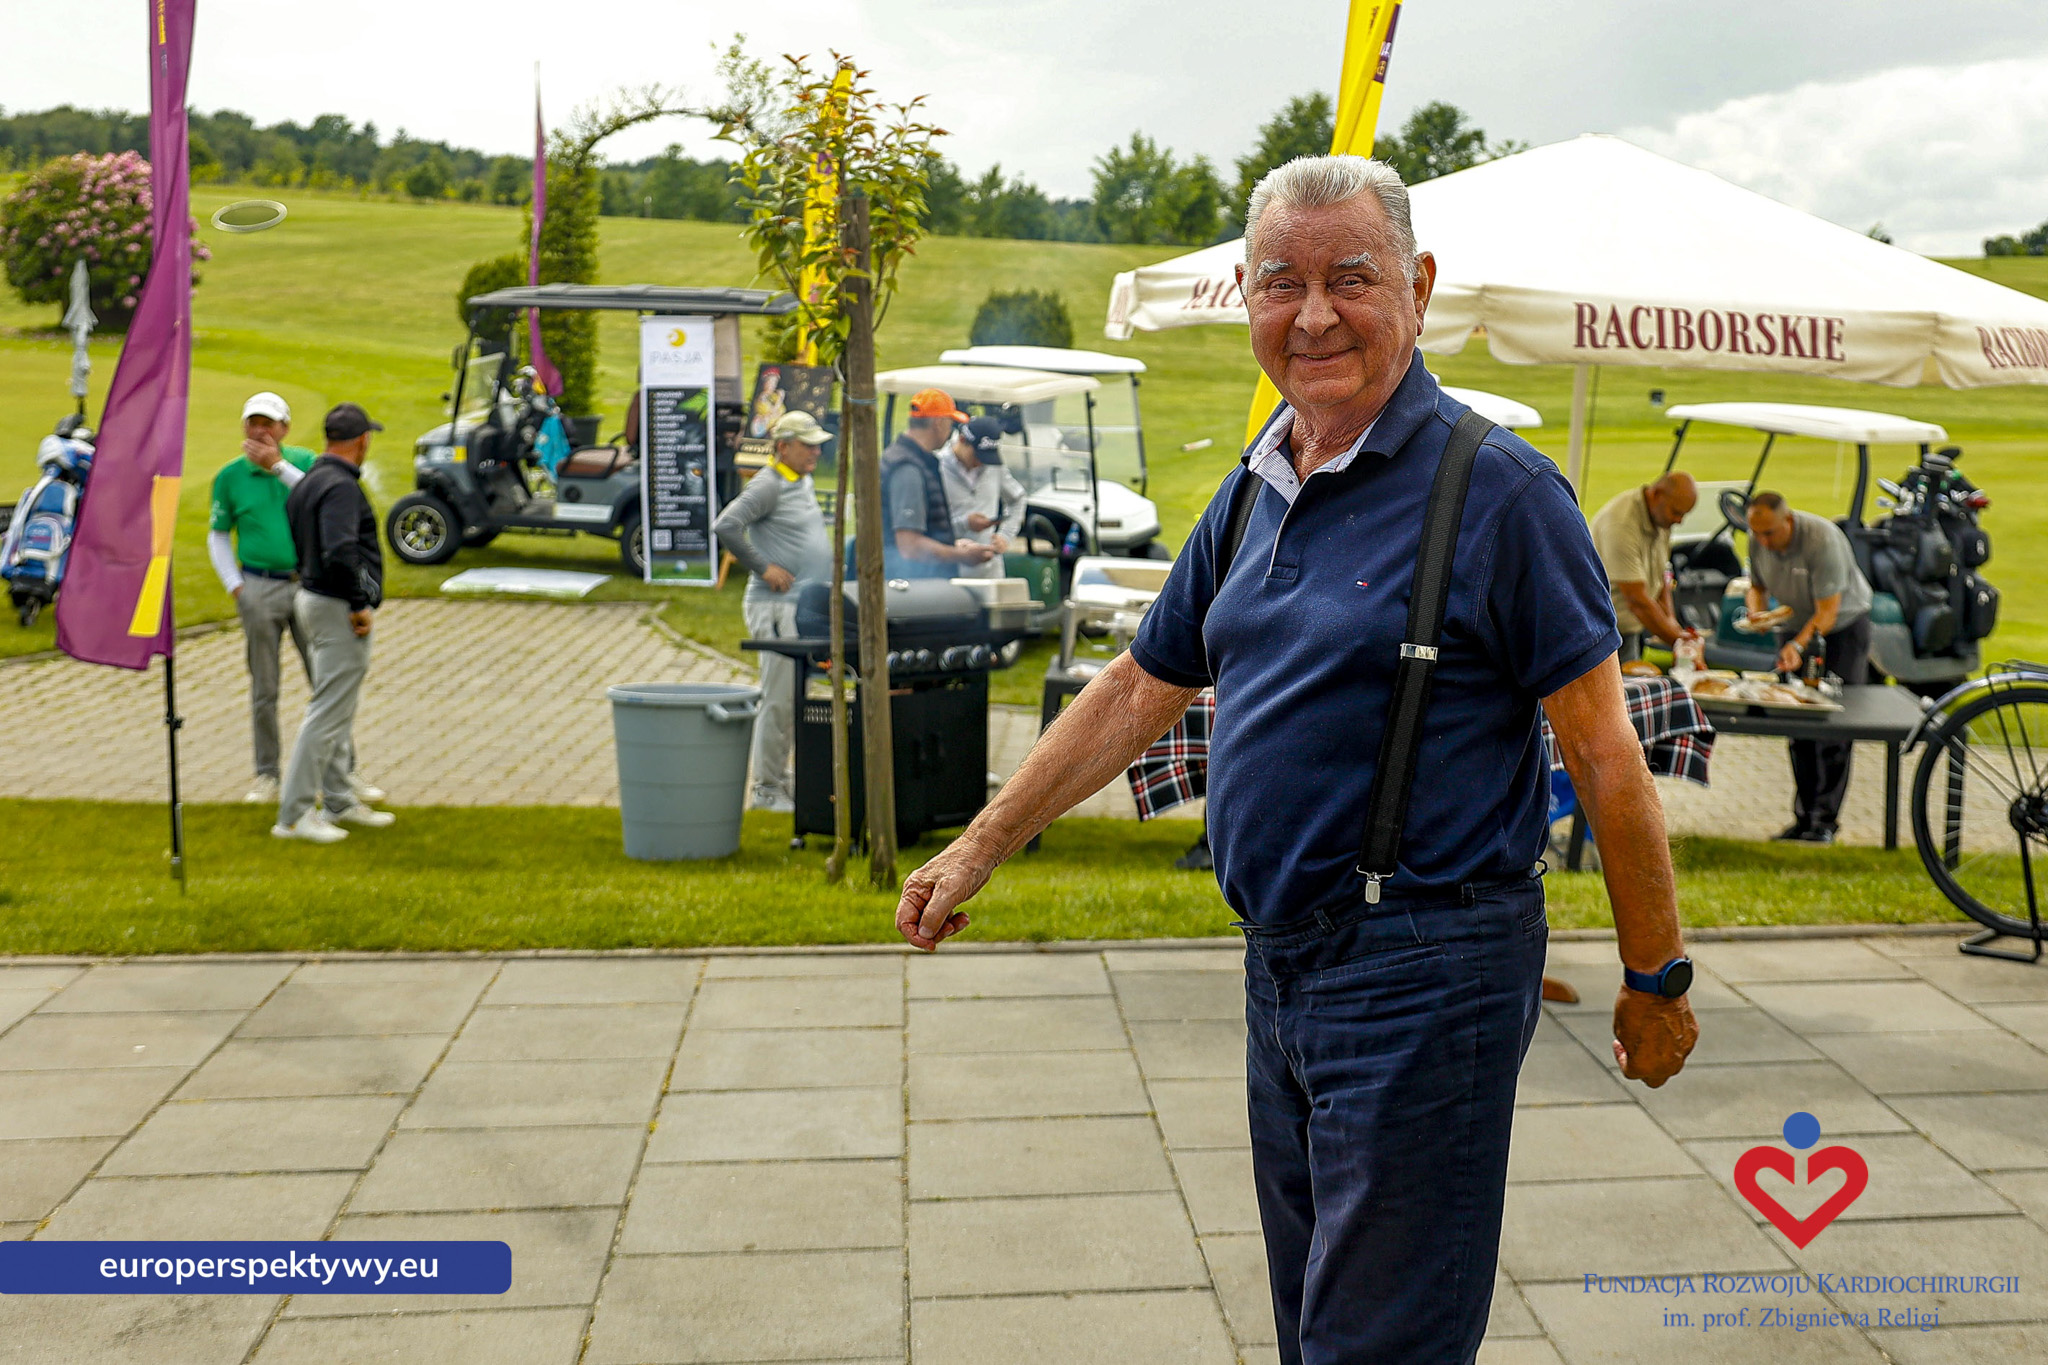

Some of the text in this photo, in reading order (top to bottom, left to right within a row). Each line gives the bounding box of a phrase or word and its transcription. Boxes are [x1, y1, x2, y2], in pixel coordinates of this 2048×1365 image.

[1181, 278, 1244, 310] RAC
[1574, 301, 1846, 362] RACIBORSKIE
[649, 350, 704, 364] PASJA
